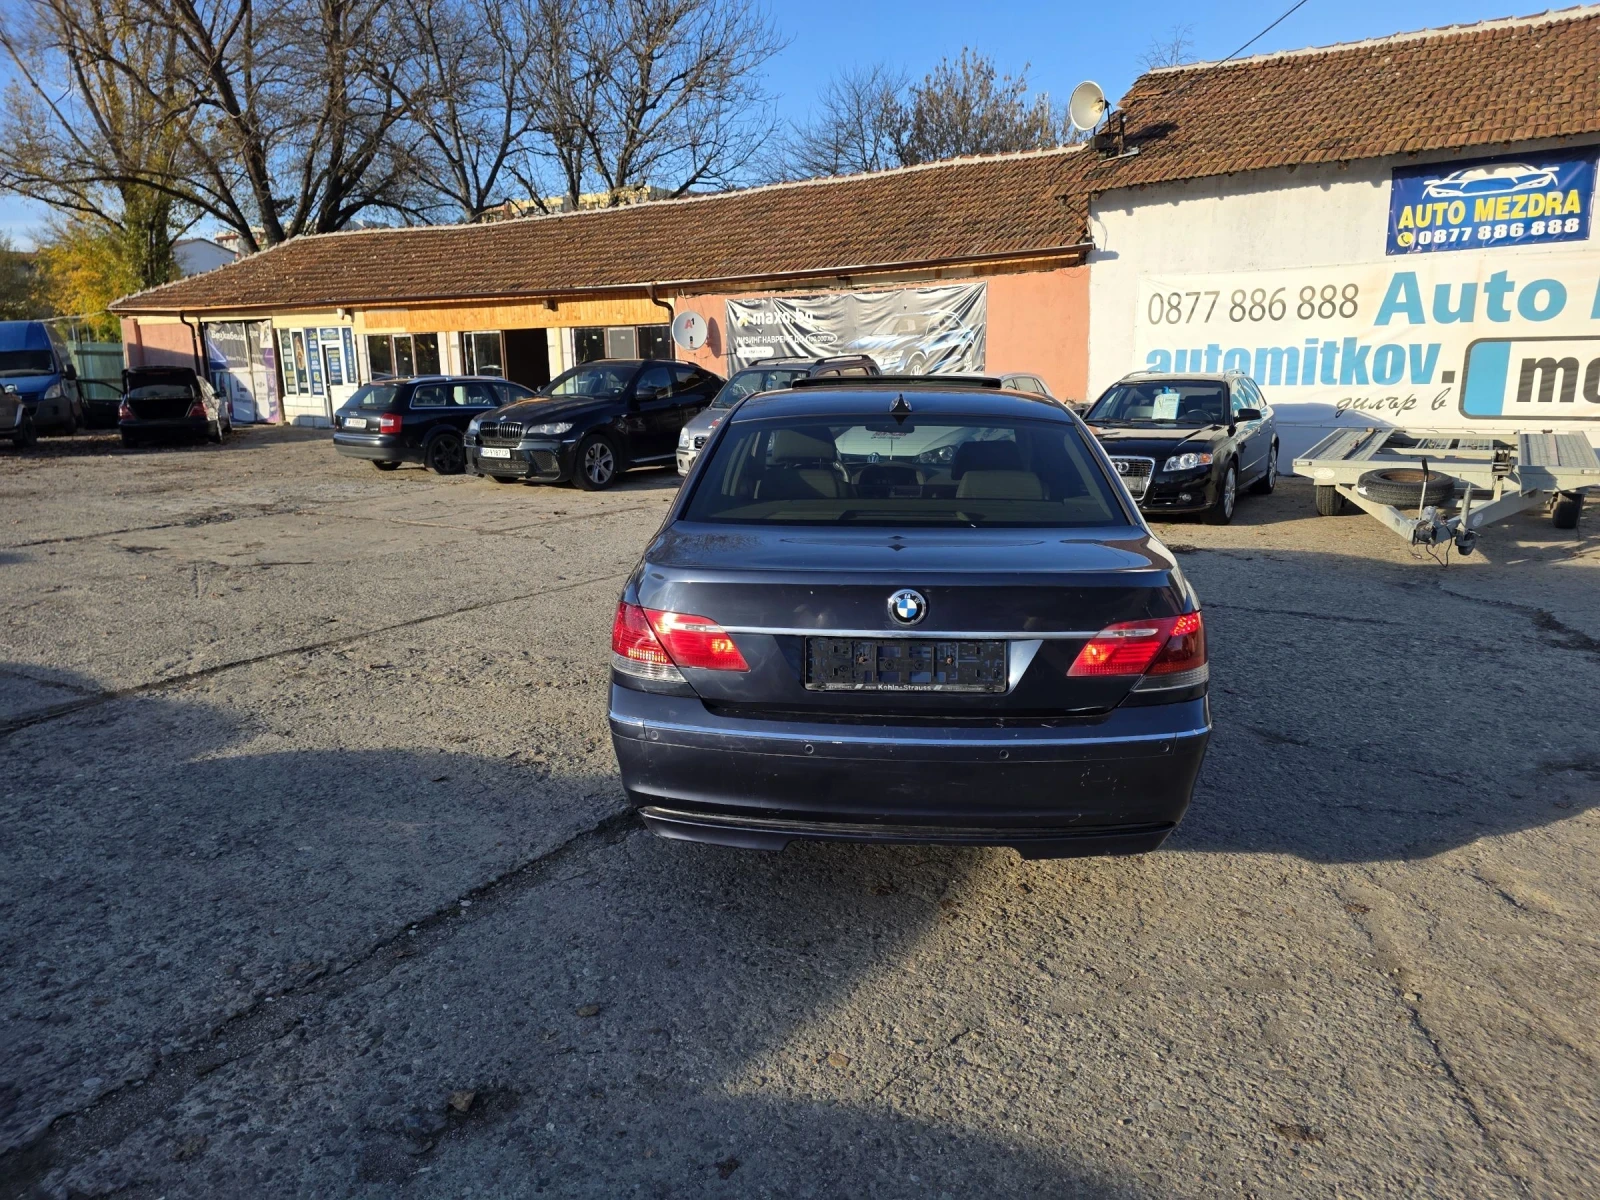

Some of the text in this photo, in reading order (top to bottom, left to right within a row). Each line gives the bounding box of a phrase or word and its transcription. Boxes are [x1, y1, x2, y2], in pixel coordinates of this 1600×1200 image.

[1398, 189, 1581, 229] AUTO MEZDRA
[1418, 218, 1580, 245] 0877 886 888
[1147, 291, 1221, 325] 0877
[1228, 287, 1286, 323] 886
[1296, 283, 1360, 320] 888
[1373, 269, 1568, 326] Auto
[684, 317, 695, 329] A1
[1335, 387, 1452, 419] дилър в
